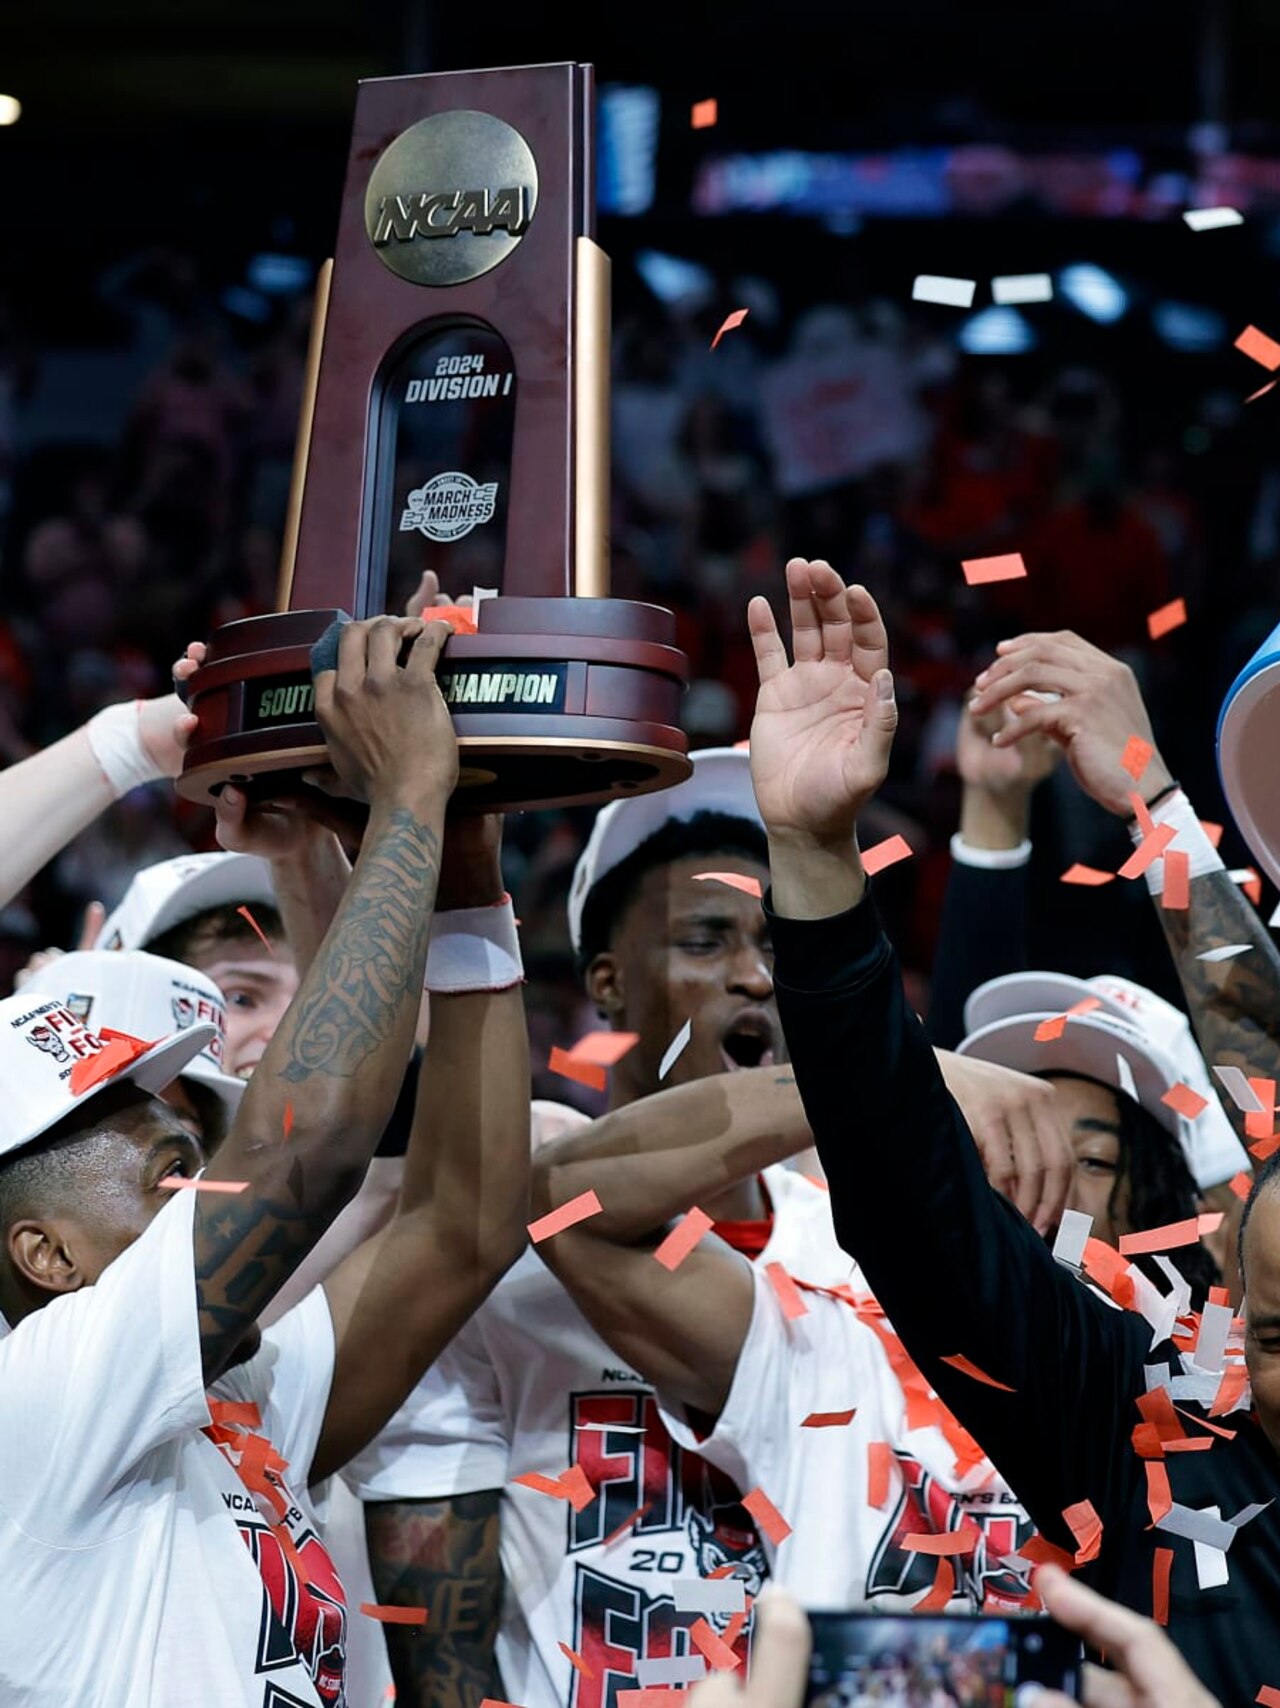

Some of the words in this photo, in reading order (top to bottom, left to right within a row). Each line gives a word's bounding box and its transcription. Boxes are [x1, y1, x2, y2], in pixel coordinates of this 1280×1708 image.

[374, 186, 531, 243] NCAA
[435, 354, 485, 376] 2024
[404, 373, 500, 403] DIVISION
[502, 372, 513, 396] I
[423, 489, 472, 506] MARCH
[428, 502, 493, 520] MADNESS
[222, 1492, 258, 1513] NCA
[629, 1550, 684, 1574] 20
